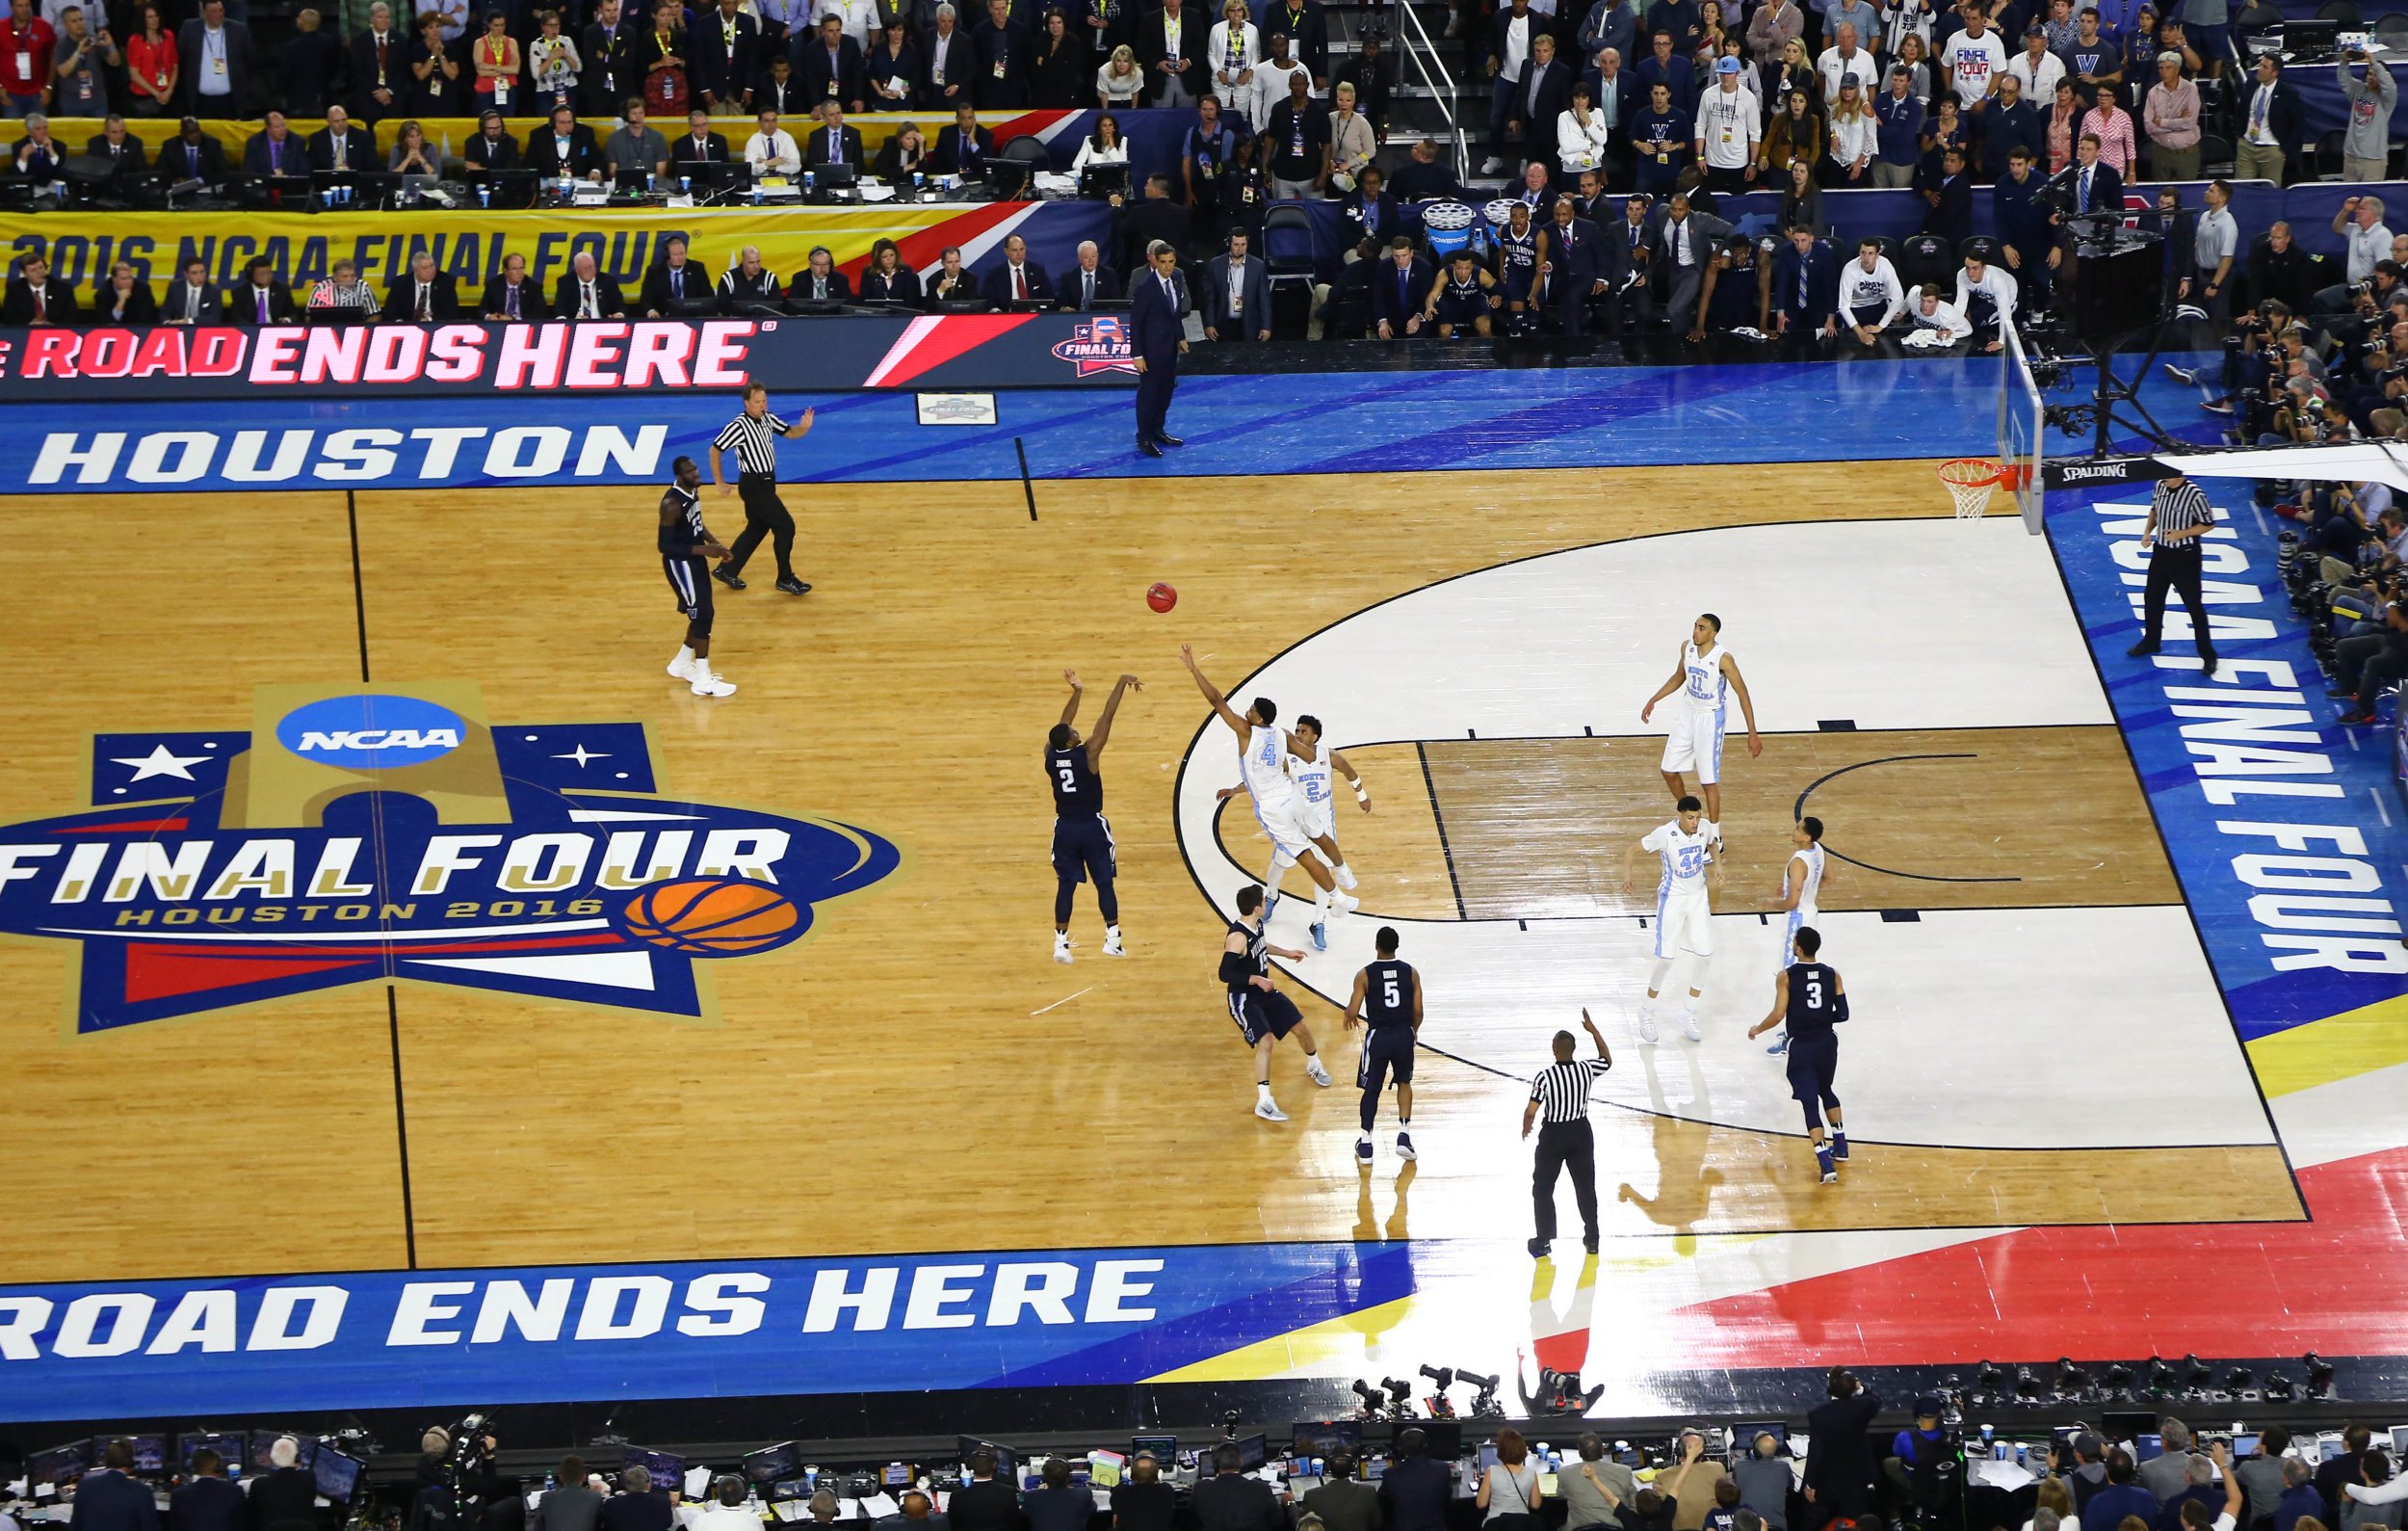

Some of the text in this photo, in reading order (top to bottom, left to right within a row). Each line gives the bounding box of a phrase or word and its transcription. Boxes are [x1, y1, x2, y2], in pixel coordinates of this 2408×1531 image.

[1957, 49, 1989, 62] FINAL
[2076, 54, 2100, 74] V
[1957, 62, 1989, 74] FOUR
[1651, 123, 1669, 139] V
[6, 234, 156, 290] 2016
[1512, 253, 1533, 267] 25
[19, 328, 248, 380] ROAD
[248, 323, 489, 384] ENDS
[1064, 344, 1109, 356] FINAL
[27, 424, 670, 485] HOUSTON
[2062, 462, 2128, 482] SPALDING
[1691, 674, 1702, 692] 11
[297, 728, 459, 752] NCAA
[2151, 654, 2346, 806] FINAL
[1261, 744, 1276, 766] 4
[1060, 769, 1077, 793] 2
[1297, 773, 1325, 782] NORTH
[1306, 781, 1320, 796] 2
[0, 827, 792, 905] FINAL FOUR
[1680, 852, 1703, 871] 44
[2215, 819, 2408, 975] FOUR
[115, 898, 605, 926] HOUSTON 2016
[1384, 981, 1400, 1008] 5
[1806, 982, 1822, 1009] 3
[0, 1258, 1165, 1360] ROAD ENDS HERE
